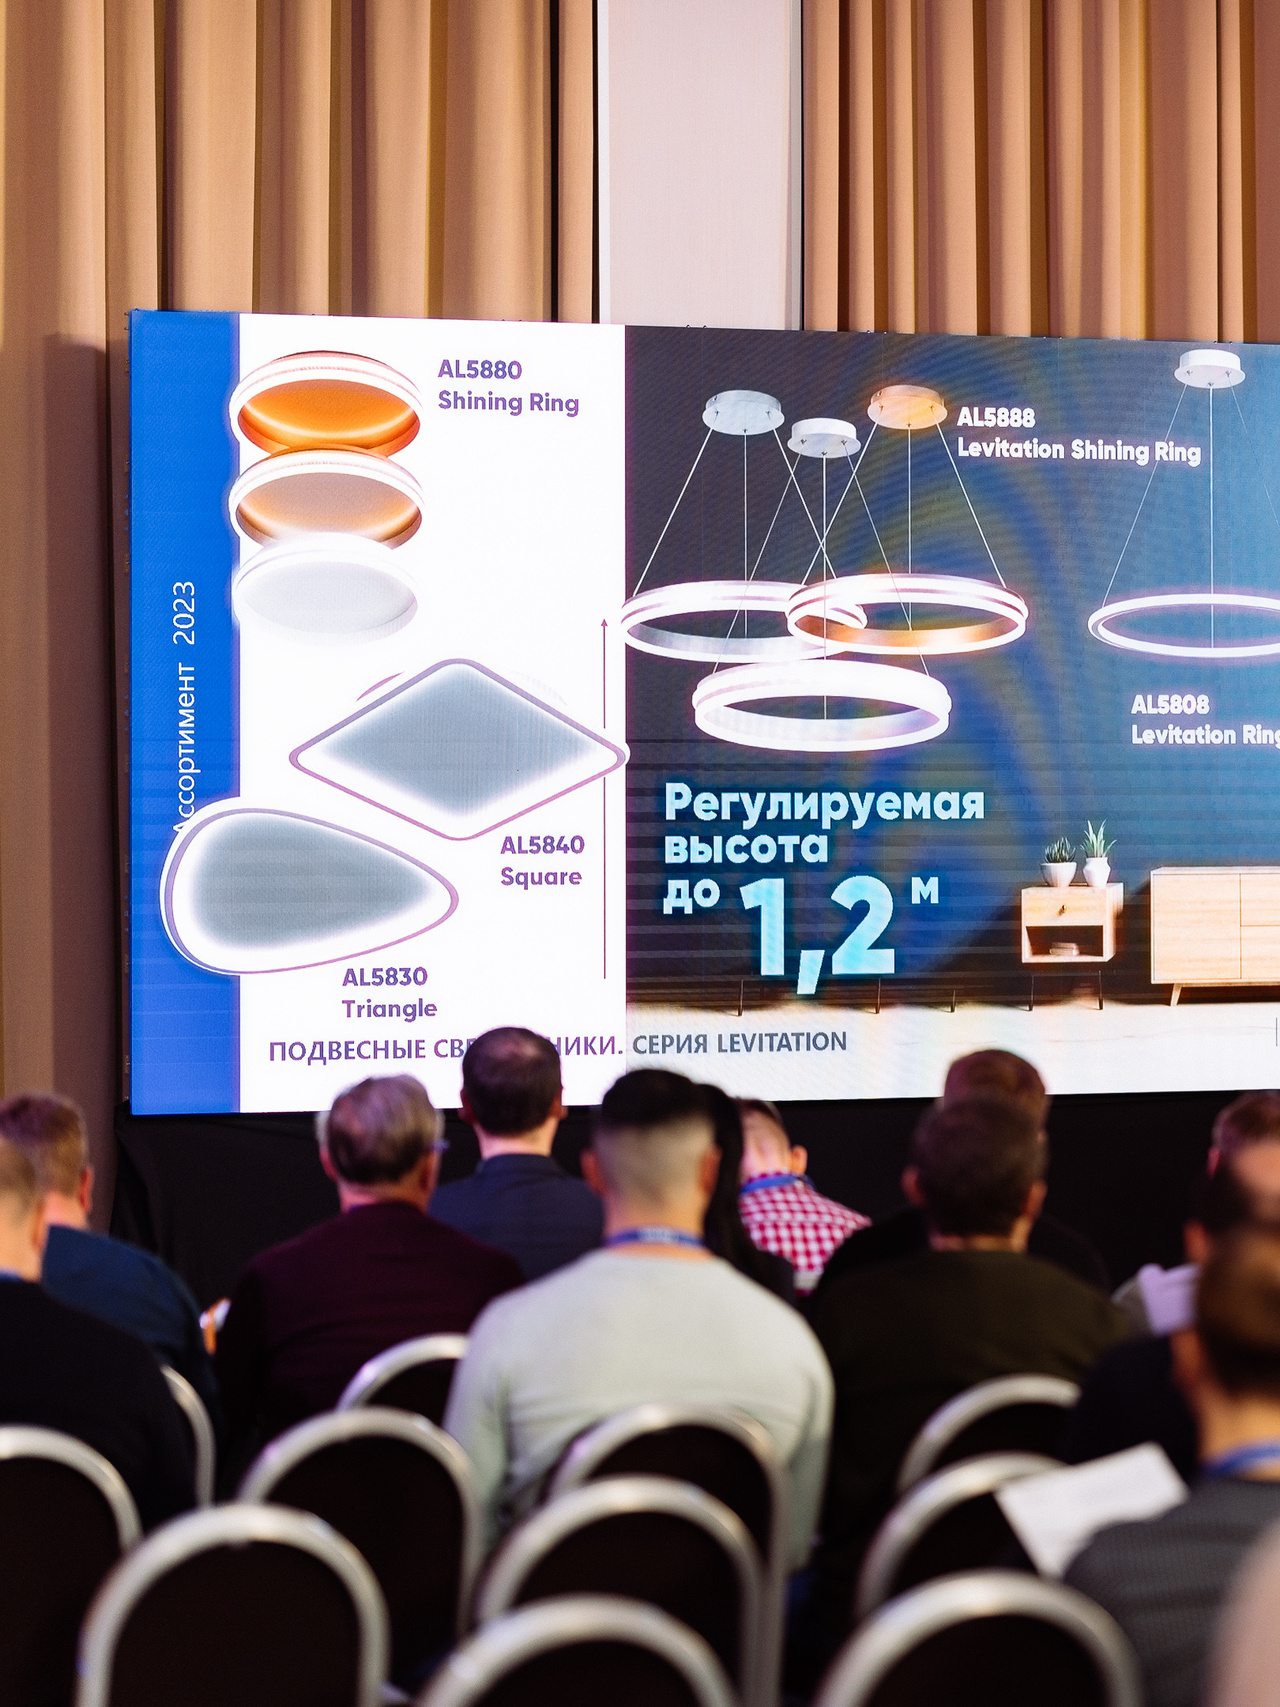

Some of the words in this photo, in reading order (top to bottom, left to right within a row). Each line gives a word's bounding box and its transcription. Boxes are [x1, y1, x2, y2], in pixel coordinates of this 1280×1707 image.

[437, 359, 522, 380] AL5880
[438, 390, 523, 416] Shining
[530, 392, 579, 418] Ring
[957, 406, 1036, 428] AL5888
[957, 437, 1065, 459] Levitation
[1071, 439, 1150, 466] Shining
[1154, 441, 1202, 467] Ring
[172, 581, 196, 645] 2023
[1131, 694, 1210, 715] AL5808
[1131, 724, 1237, 745] Levitation
[665, 782, 985, 830] Регулируемая
[500, 835, 585, 855] AL5840
[664, 834, 828, 864] высота
[500, 867, 583, 890] Square
[663, 878, 721, 915] до
[739, 875, 896, 995] 1,2
[911, 876, 939, 904] м
[342, 967, 428, 987] AL5830
[341, 998, 438, 1023] Triangle
[269, 1039, 426, 1066] ПОДВЕСНЫЕ
[632, 1034, 708, 1055] СЕРИЯ
[717, 1031, 847, 1053] LEVITATION
